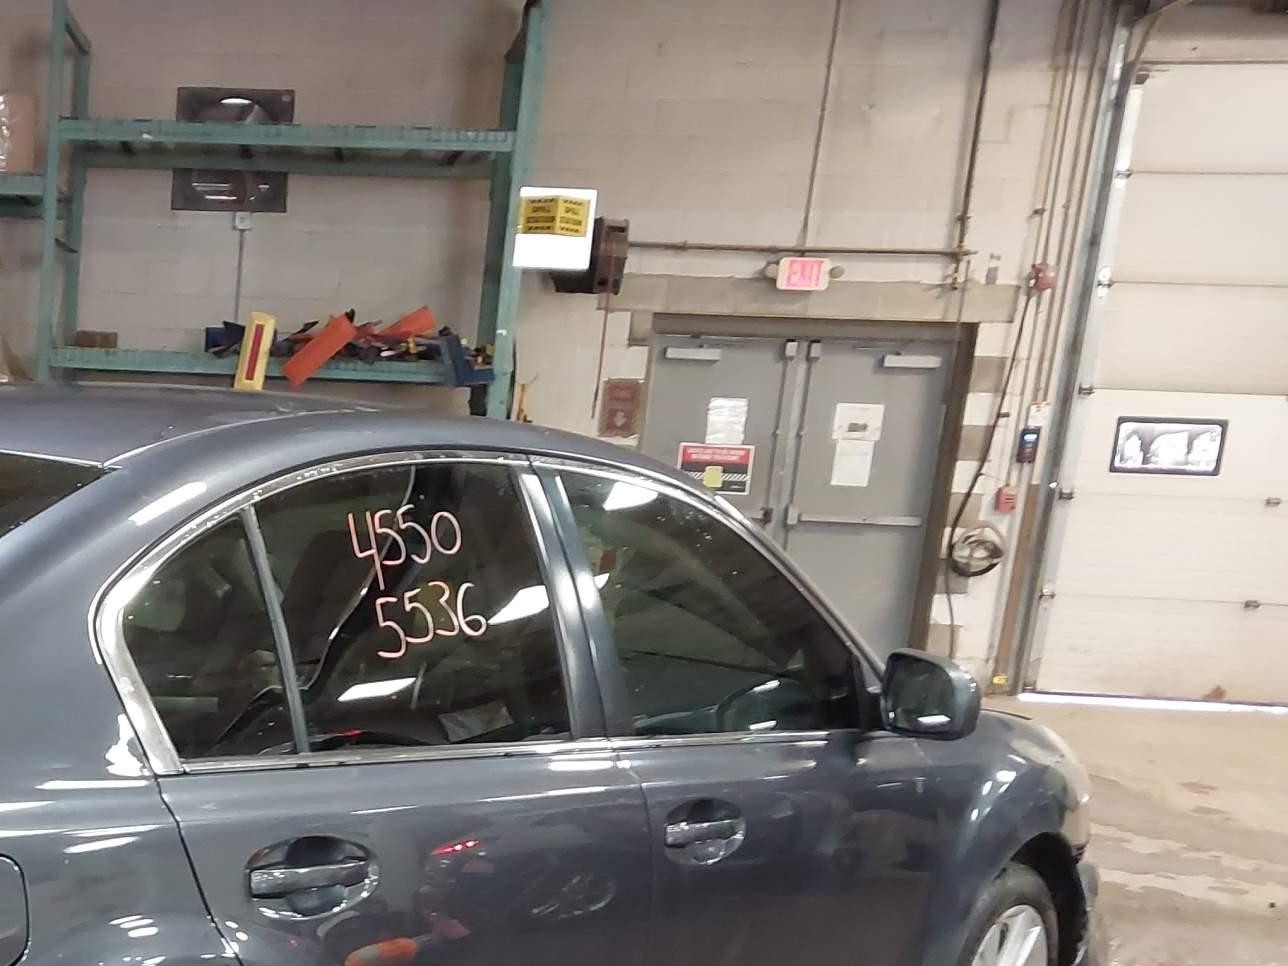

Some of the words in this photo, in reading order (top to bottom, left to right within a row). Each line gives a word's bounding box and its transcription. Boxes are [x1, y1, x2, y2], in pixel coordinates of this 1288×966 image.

[786, 259, 825, 288] EXIT
[347, 504, 462, 590] 4550
[375, 581, 488, 658] 5536
